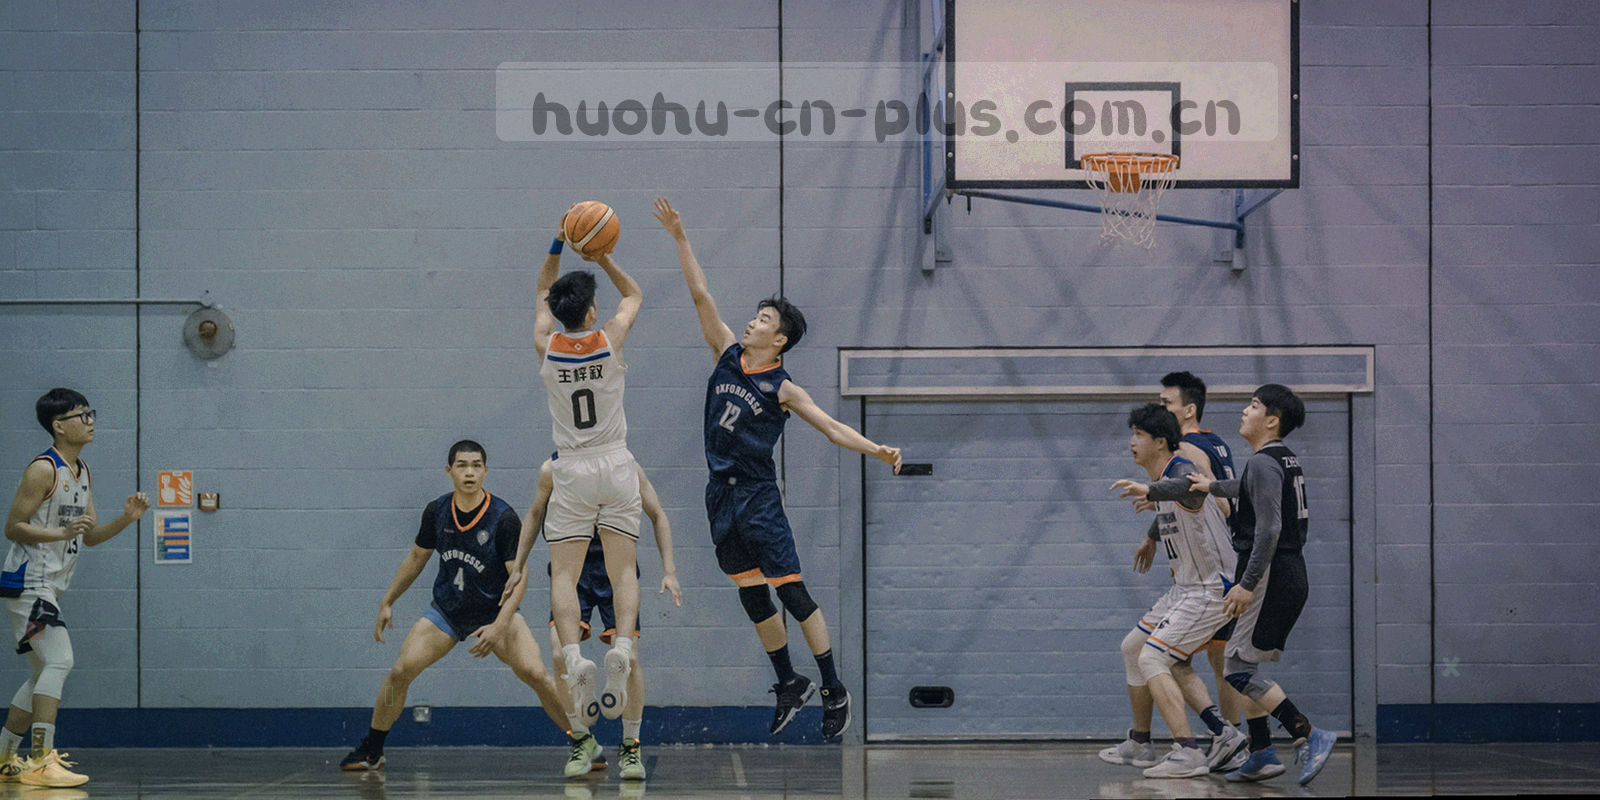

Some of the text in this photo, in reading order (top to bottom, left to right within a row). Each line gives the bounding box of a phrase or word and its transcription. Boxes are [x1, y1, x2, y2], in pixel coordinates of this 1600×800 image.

[571, 388, 598, 430] 0
[715, 383, 763, 416] OXFORD CSSA
[719, 400, 742, 432] 12
[453, 567, 465, 591] 4
[464, 553, 486, 574] CSSA
